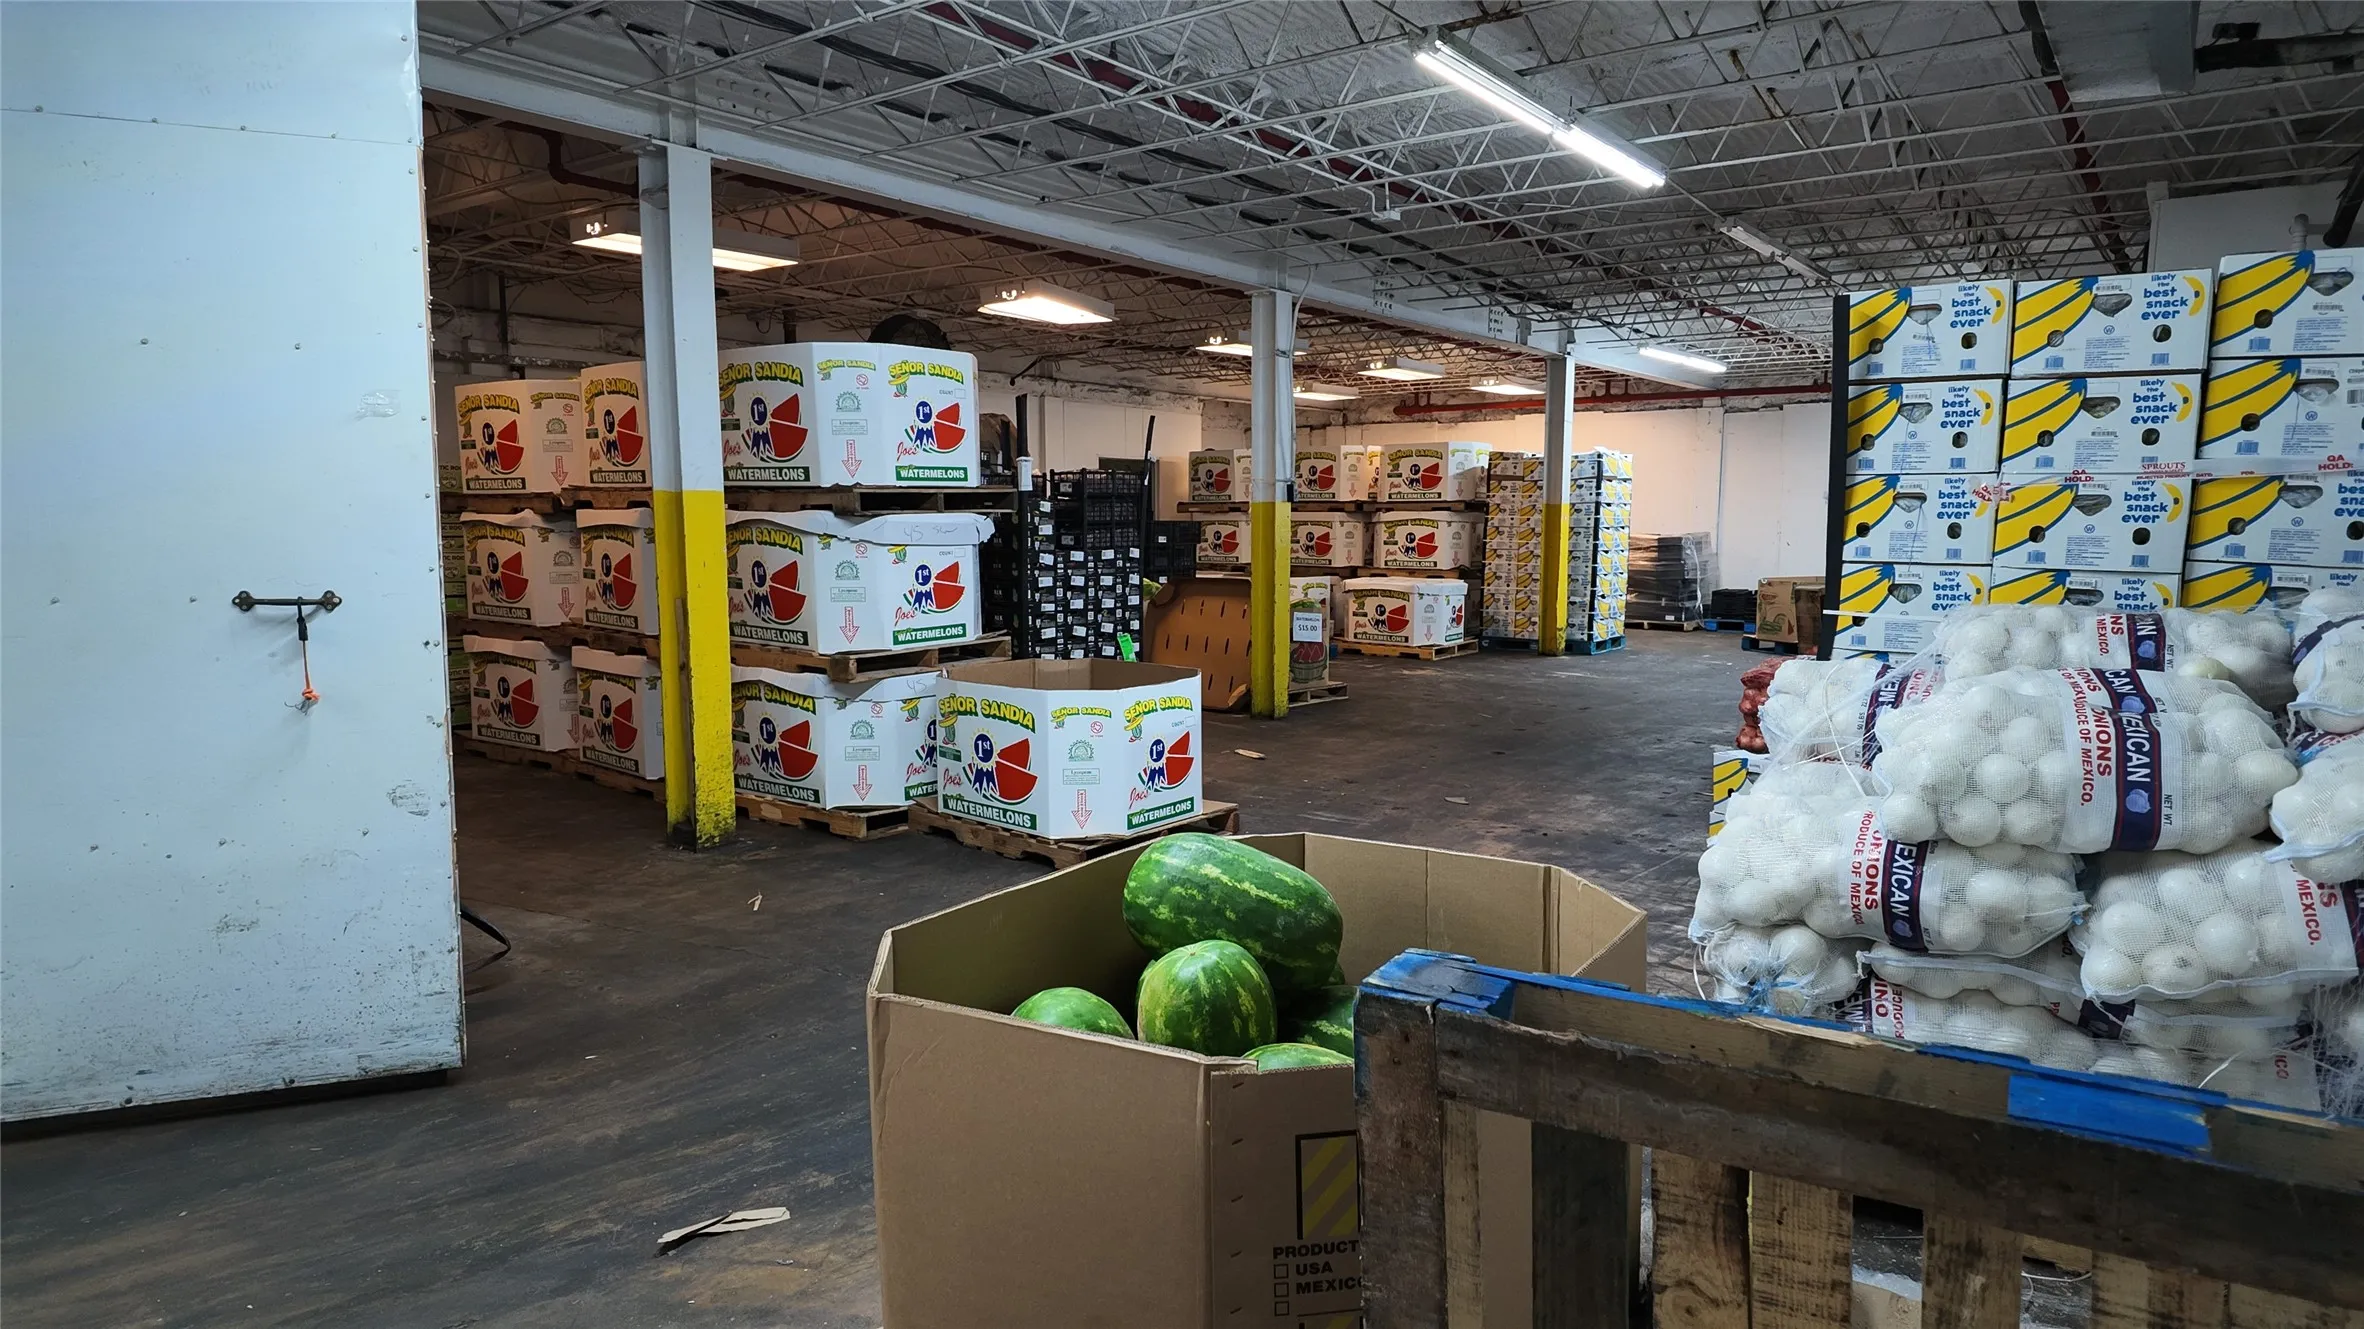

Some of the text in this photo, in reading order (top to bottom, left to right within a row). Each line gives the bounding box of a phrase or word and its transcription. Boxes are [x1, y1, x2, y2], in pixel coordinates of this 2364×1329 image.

[2151, 273, 2176, 282] likely
[1958, 284, 1980, 292] likely
[2143, 288, 2177, 299] best
[1952, 298, 1981, 307] best
[2146, 297, 2189, 308] snack
[1954, 306, 1991, 317] snack
[2141, 309, 2180, 320] ever
[1950, 318, 1985, 328] ever
[755, 362, 804, 387] SANDIA
[888, 360, 964, 384] SEÑOR SANDIA
[2140, 379, 2165, 387] likely
[605, 378, 639, 400] SANDIA
[2133, 392, 2167, 403] best
[483, 393, 520, 414] SANDIA
[1942, 399, 1971, 408] best
[2135, 402, 2178, 413] snack
[753, 403, 764, 421] 1st
[918, 405, 930, 420] 1st
[1944, 408, 1981, 417] snack
[1940, 419, 1974, 429] ever
[2131, 414, 2170, 424] ever
[2327, 454, 2345, 462] QA
[2141, 462, 2186, 470] SPROUTS
[2318, 463, 2353, 471] HOLD:
[592, 472, 643, 483] WATERMELONS
[727, 467, 805, 481] WATERMELONS
[900, 468, 965, 479] WATERMELONS
[2347, 469, 2364, 477] like
[469, 479, 523, 490] WATERMELONS
[1944, 477, 1966, 485] likely
[2064, 475, 2095, 483] HOLD:
[1938, 490, 1967, 499] best
[2338, 484, 2364, 494] bes
[2124, 492, 2157, 502] best
[2340, 496, 2364, 505] sna
[1940, 500, 1977, 509] snack
[2126, 502, 2169, 513] snack
[1937, 511, 1971, 519] ever
[2334, 508, 2364, 517] eve
[2121, 514, 2160, 524] ever
[755, 527, 804, 555] SANDIA
[753, 564, 765, 582] 1st
[917, 568, 930, 583] 1st
[2330, 573, 2358, 582] likely
[1933, 582, 1962, 591] best
[2121, 578, 2146, 586] likely
[1935, 592, 1971, 601] snack
[2114, 591, 2147, 601] best
[475, 606, 528, 619] WATERMELONS
[587, 612, 636, 627] WATERMELONS
[1298, 624, 1317, 632] $15.00
[732, 625, 804, 644] WATERMELONS
[897, 626, 963, 642] WATERMELONS
[1356, 633, 1406, 643] WATERMELONS
[763, 687, 816, 715] SANDIA
[1123, 696, 1193, 718] SEÑOR SANDIA
[938, 693, 1036, 733] SEÑOR SANDIA
[762, 721, 774, 739] 1st
[480, 727, 537, 745] WATERMELONS
[977, 740, 990, 758] 1st
[1149, 741, 1163, 759] 1st
[584, 749, 636, 771] WATERMELONS
[2079, 729, 2094, 807] OF MEXICO.
[738, 779, 815, 802] WATERMELONS
[2164, 794, 2172, 810] NET
[947, 798, 1032, 828] WATERMELONS
[1131, 800, 1192, 825] WATERMELONS
[1854, 811, 1875, 856] RODUCE
[1851, 861, 1862, 879] OF
[1889, 842, 1918, 917] EXICAN
[2296, 879, 2322, 945] MEXICO.
[1874, 980, 1889, 1018] ONI
[1892, 988, 1904, 1039] RODUCE
[1273, 1240, 1359, 1260] PRODUCT
[1296, 1261, 1333, 1276] USA
